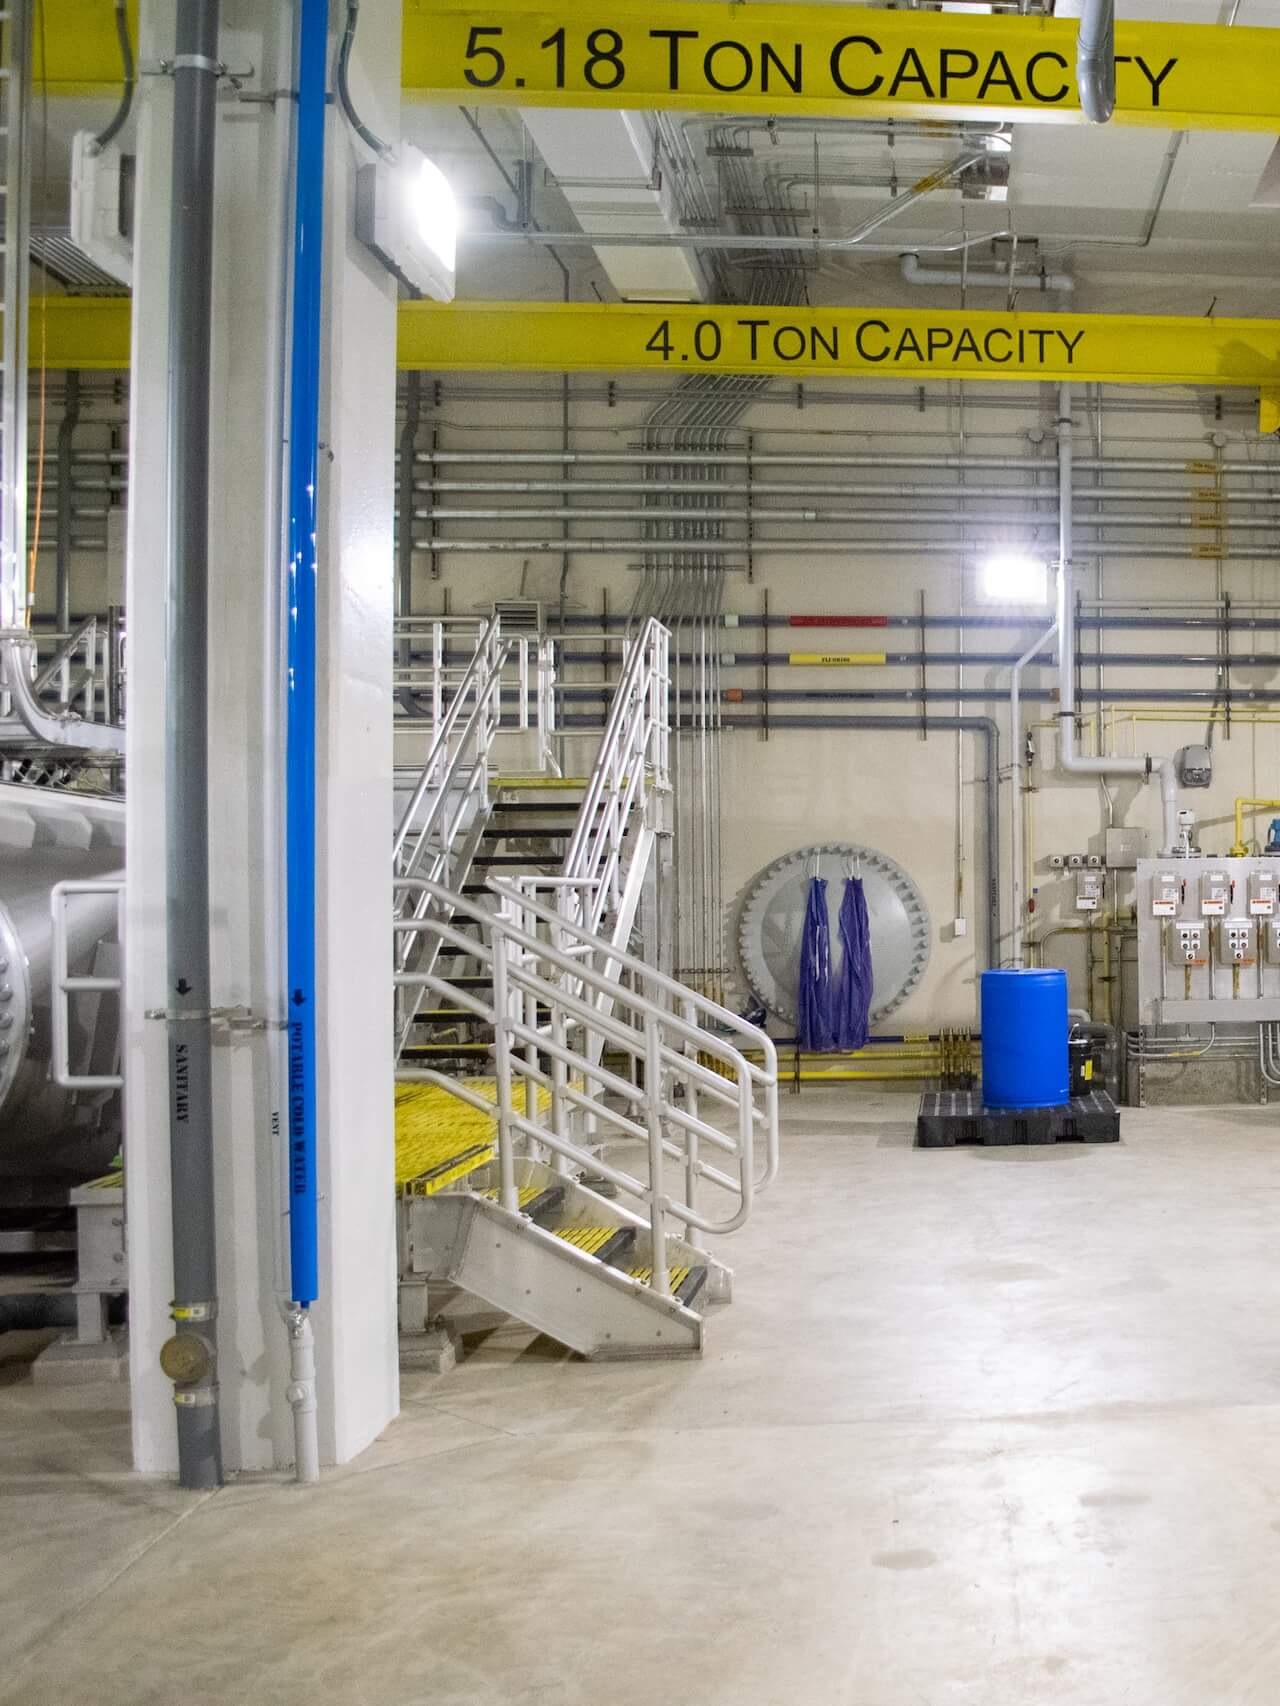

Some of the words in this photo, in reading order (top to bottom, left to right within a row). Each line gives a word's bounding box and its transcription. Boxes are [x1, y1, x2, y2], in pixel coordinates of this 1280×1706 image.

[463, 26, 625, 90] 5.18
[829, 35, 1178, 106] CAPACY
[645, 320, 722, 361] 4.0
[175, 1044, 189, 1123] SANITARY
[291, 1022, 304, 1089] POTABLE
[294, 1141, 306, 1194] WATER
